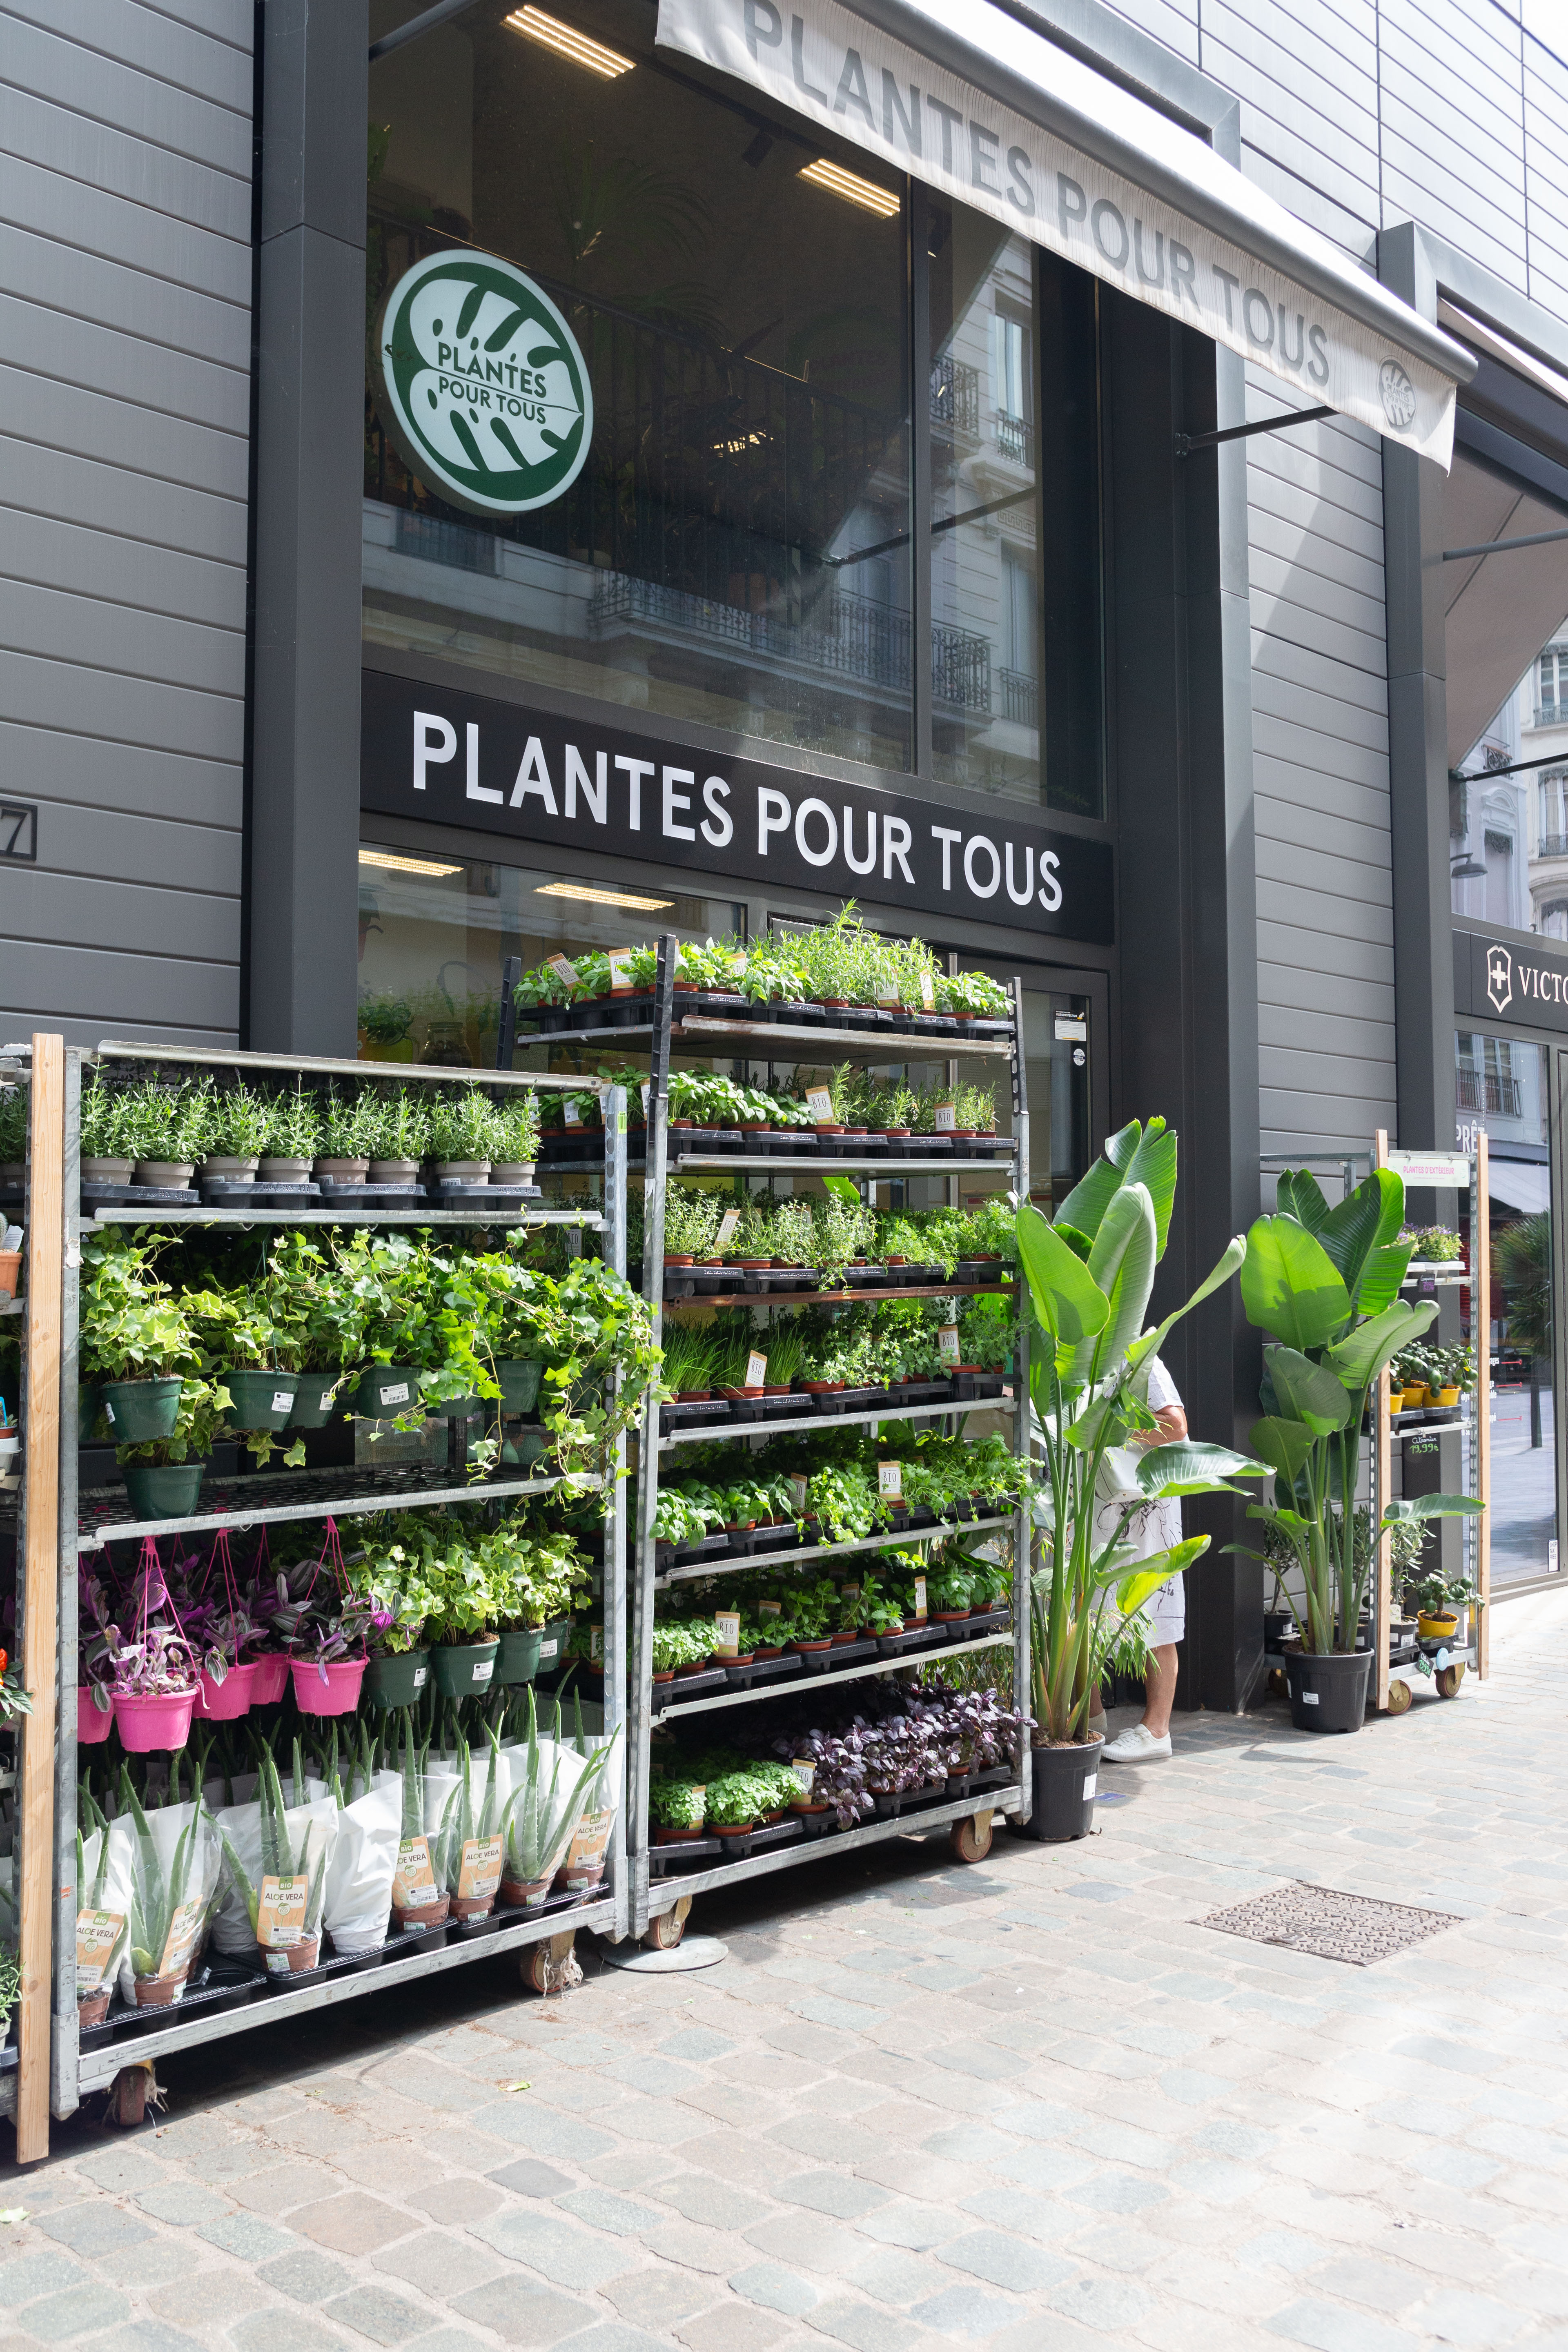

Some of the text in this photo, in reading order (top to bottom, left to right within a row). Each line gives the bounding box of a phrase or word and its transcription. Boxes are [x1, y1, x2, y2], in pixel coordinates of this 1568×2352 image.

[744, 0, 1329, 388] PLANTES POUR TOUS
[438, 341, 547, 399] PLANTES
[1387, 383, 1409, 402] PLANTES
[439, 376, 546, 425] POUR TOUS
[413, 710, 1063, 911] PLANTES POUR TOUS
[556, 964, 570, 975] BIO
[812, 1097, 826, 1109] BIO
[939, 1112, 951, 1123] BIO
[1403, 1165, 1455, 1175] PLANTES D'EXTÉRIEUR
[298, 1184, 310, 1193] 480
[175, 1191, 188, 1200] 480
[722, 1219, 733, 1231] BIO
[942, 1336, 954, 1347] BIO
[751, 1361, 762, 1376] BIO
[1409, 1443, 1439, 1454] 19,99€
[883, 1472, 897, 1483] BIO
[720, 1621, 734, 1634] BIO
[594, 1823, 607, 1831] VERA
[397, 1853, 427, 1865] OE VERA
[484, 1849, 499, 1858] VERA
[173, 1912, 198, 1931] ALOE VERA
[77, 1927, 114, 1939] ALOE VERA
